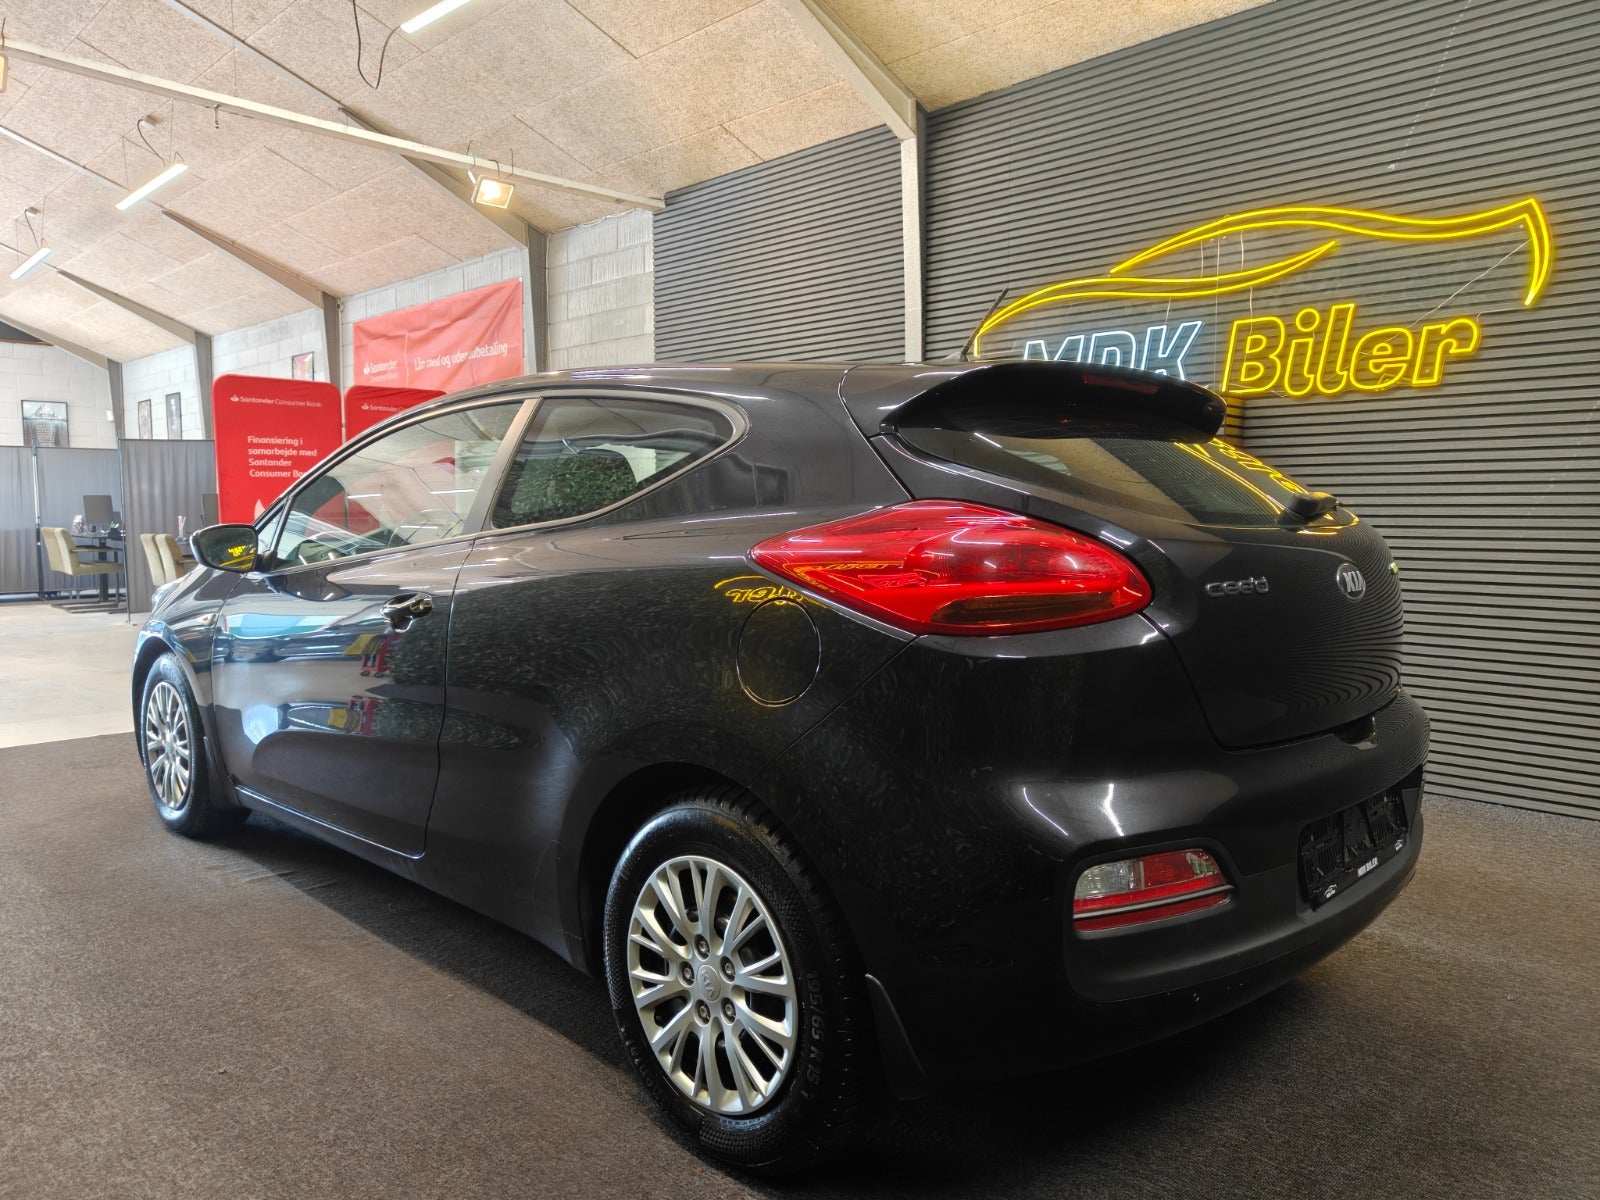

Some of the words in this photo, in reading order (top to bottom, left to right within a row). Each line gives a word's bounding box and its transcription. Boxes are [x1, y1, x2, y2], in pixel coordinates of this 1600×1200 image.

[441, 355, 451, 368] og
[468, 340, 508, 359] betaling
[1221, 302, 1481, 397] Biler
[369, 359, 398, 374] Santander
[239, 396, 274, 405] Santander
[274, 398, 306, 406] Consumer
[369, 404, 398, 412] Santander
[247, 435, 299, 446] Finansiering
[247, 447, 298, 457] samarbejde
[248, 457, 293, 466] Santander
[249, 469, 291, 477] Consumer
[1342, 570, 1365, 593] KIA
